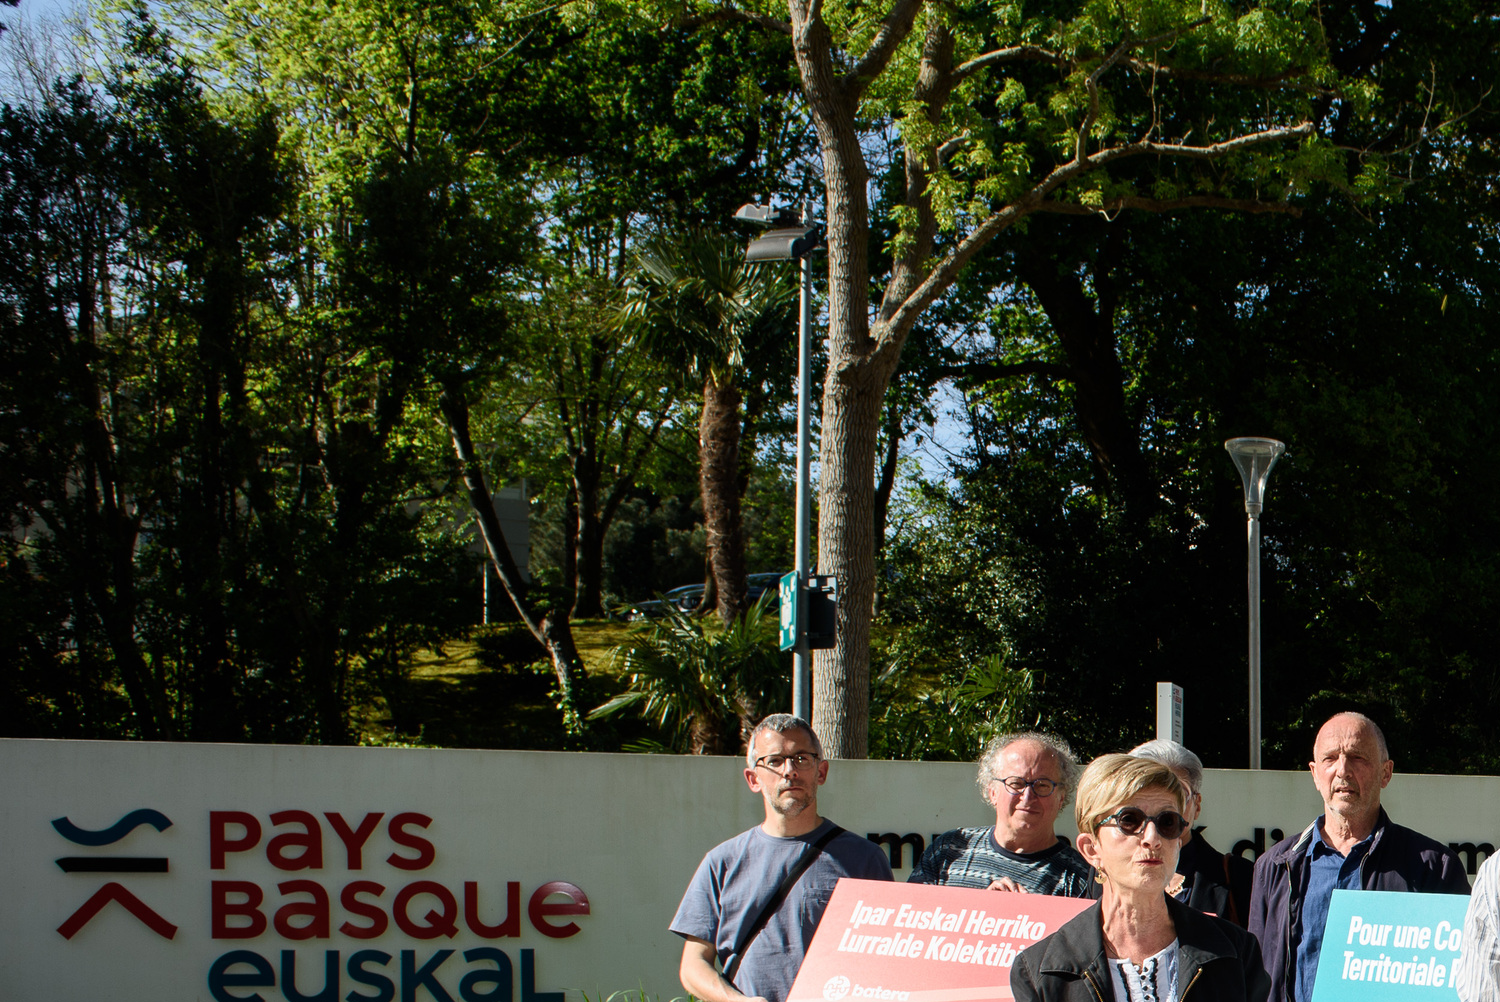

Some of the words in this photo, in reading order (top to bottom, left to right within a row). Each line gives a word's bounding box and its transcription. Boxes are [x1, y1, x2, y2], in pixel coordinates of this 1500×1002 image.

[849, 900, 895, 929] Ipar
[894, 904, 966, 933] Euskal
[964, 910, 1046, 941] Herriko
[1346, 915, 1393, 947] Pour
[1393, 925, 1431, 950] une
[1434, 920, 1463, 952] Co
[837, 928, 924, 958] Lurralde
[1342, 950, 1446, 987] Territoriale
[851, 984, 911, 1001] batera
